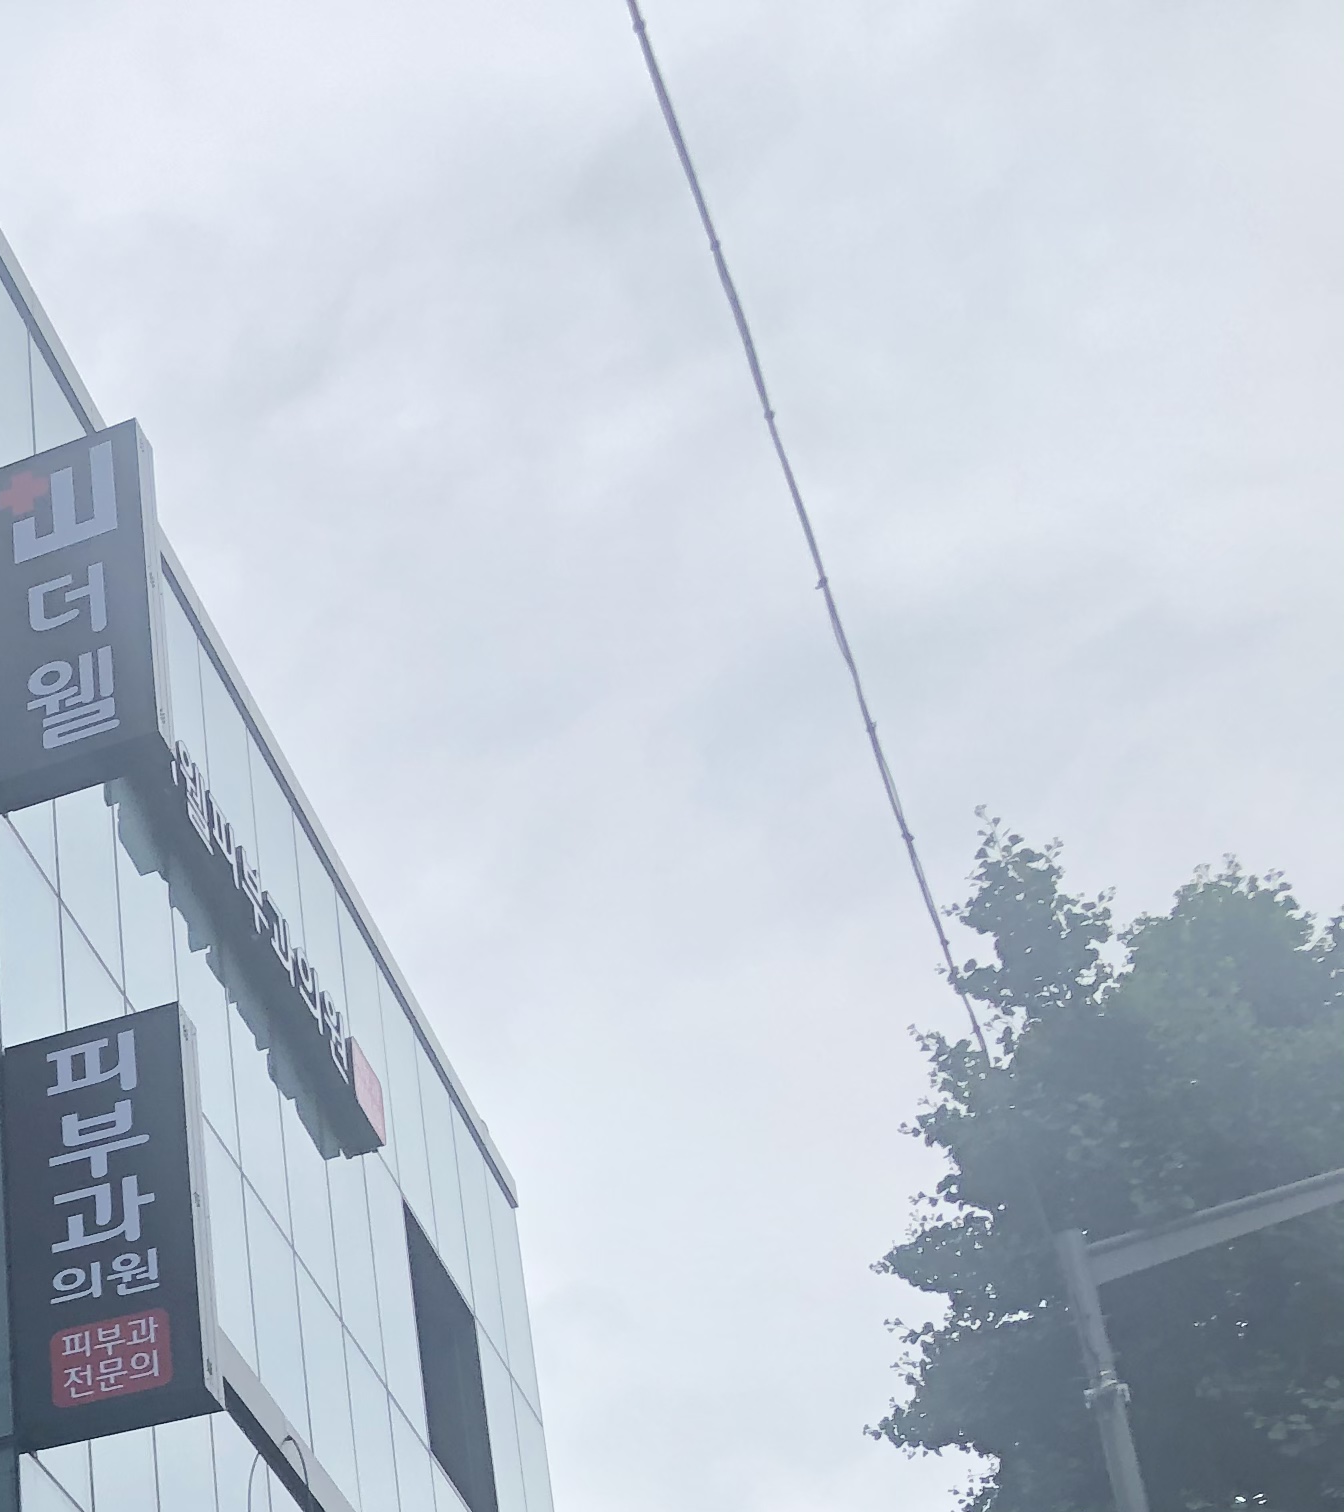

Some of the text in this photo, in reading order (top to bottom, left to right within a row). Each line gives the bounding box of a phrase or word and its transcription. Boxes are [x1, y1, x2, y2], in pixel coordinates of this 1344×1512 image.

[26, 561, 121, 749] 더웰
[170, 740, 349, 1084] 웰피부과의원
[46, 1029, 155, 1253] 피부과
[50, 1248, 160, 1305] 의원
[61, 1317, 158, 1357] 피부과
[63, 1350, 160, 1399] 전문의
